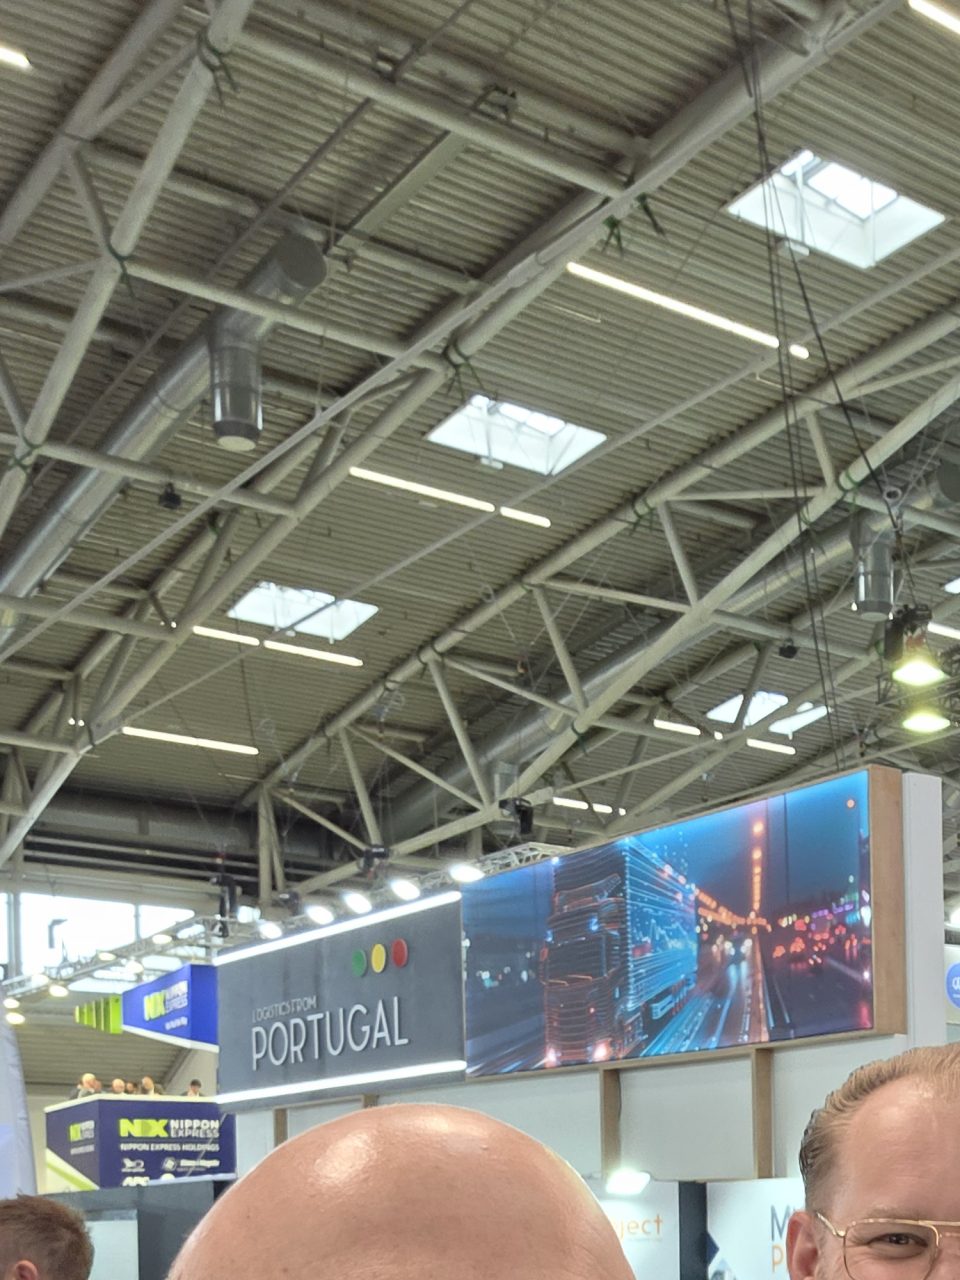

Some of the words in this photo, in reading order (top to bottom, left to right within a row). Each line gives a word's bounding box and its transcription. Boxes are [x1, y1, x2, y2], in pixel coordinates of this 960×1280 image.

[251, 995, 409, 1072] PORTUGAL
[119, 1118, 168, 1137] NX
[170, 1119, 219, 1130] NIPPON
[170, 1129, 219, 1138] EXPRESS
[120, 1143, 150, 1152] NIPPON
[150, 1143, 180, 1152] EXPRESS
[182, 1143, 219, 1152] HOLDINGS
